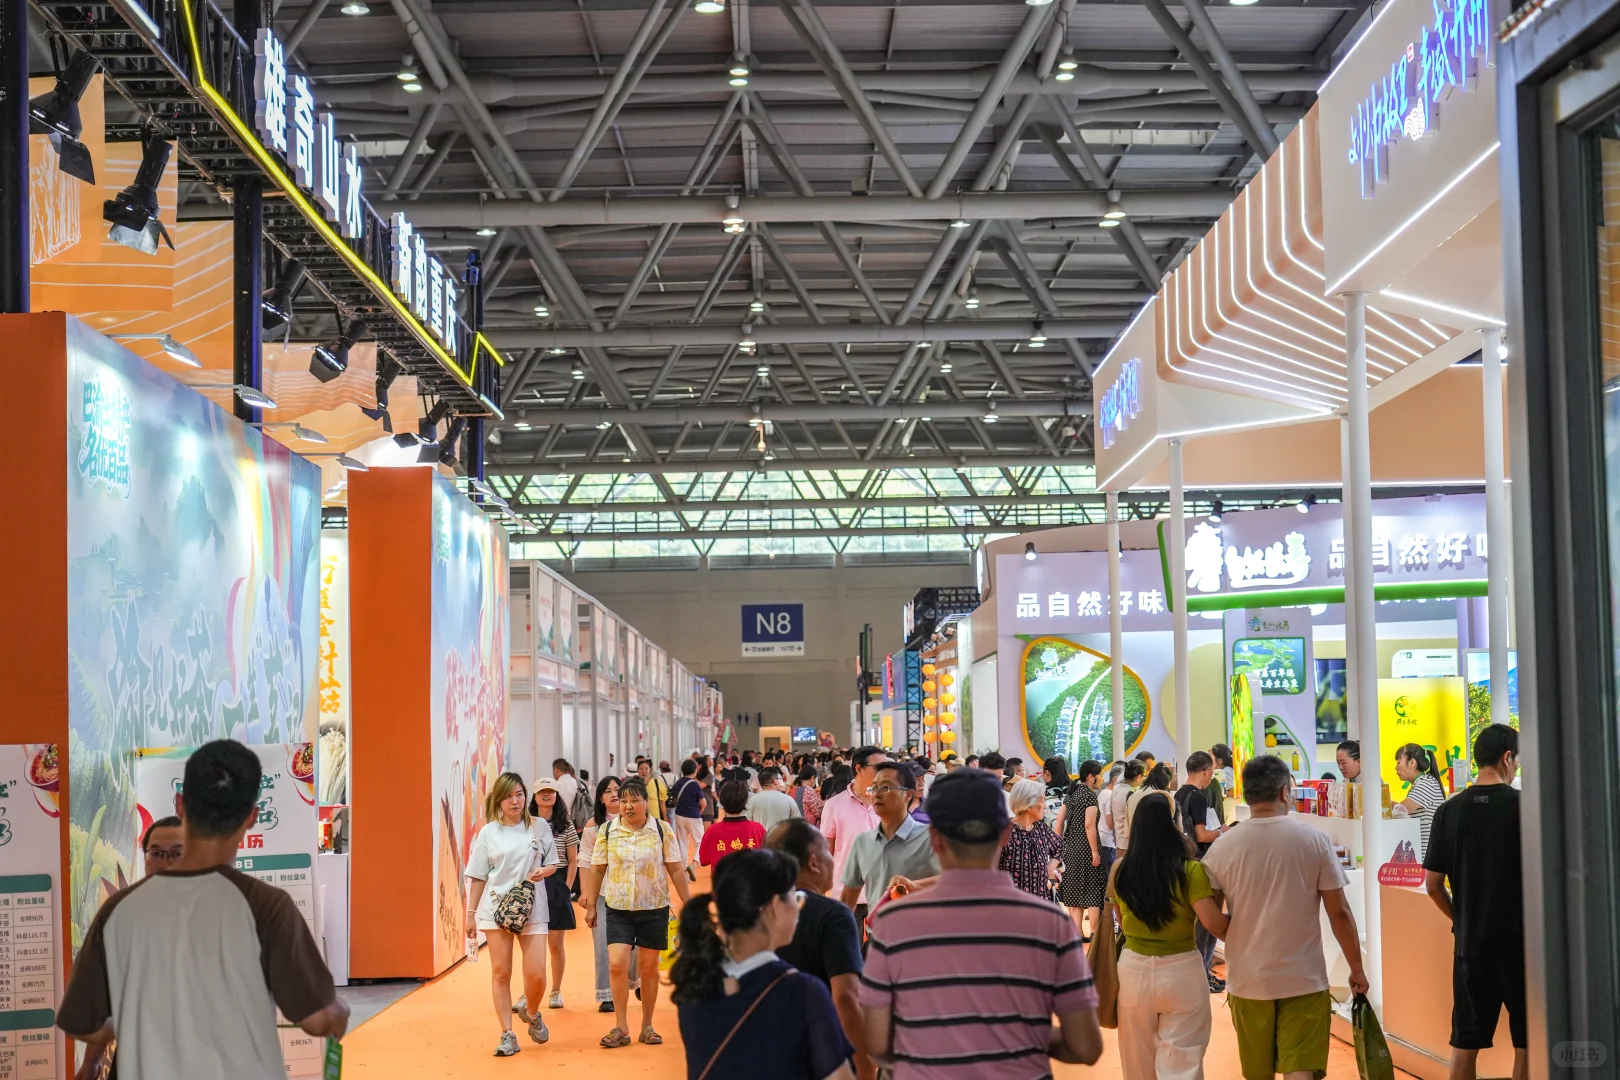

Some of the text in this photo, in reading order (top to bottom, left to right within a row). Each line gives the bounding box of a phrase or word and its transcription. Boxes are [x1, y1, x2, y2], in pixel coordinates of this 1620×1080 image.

[260, 27, 363, 239] 雄奇山水
[79, 423, 130, 486] 名优百品
[1016, 588, 1165, 618] 品自然好味
[756, 612, 791, 635] N8
[280, 873, 306, 882] 粉丝量级
[17, 896, 45, 905] 粉丝量级
[19, 963, 47, 973] 全网100万
[21, 979, 46, 989] 全网75万
[21, 1033, 50, 1042] 粉丝量级
